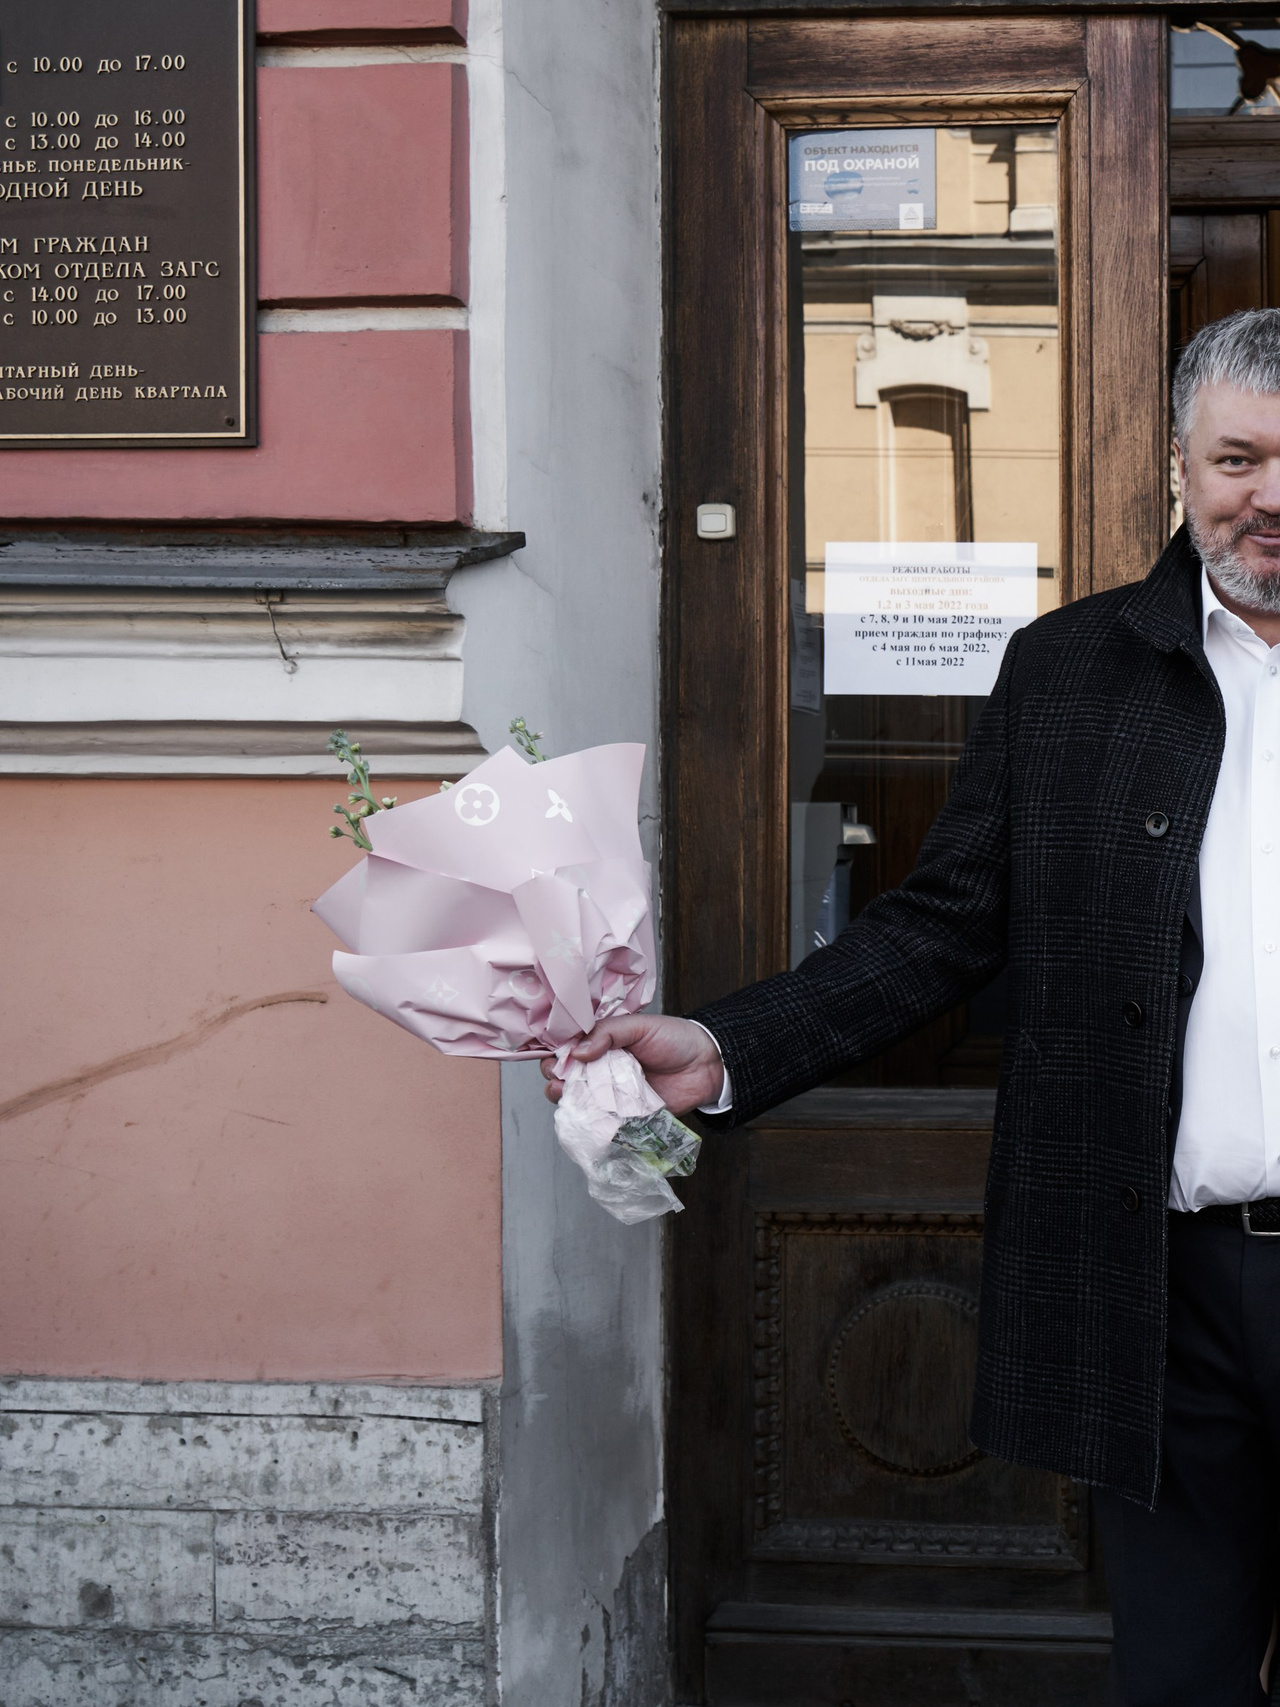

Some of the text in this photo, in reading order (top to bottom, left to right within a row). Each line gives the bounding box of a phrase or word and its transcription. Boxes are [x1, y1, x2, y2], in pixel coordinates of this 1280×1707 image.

[6, 54, 185, 74] с 10.00 до 17.00
[5, 109, 185, 129] с 10.00 до 16.00
[4, 131, 186, 151] с 13.00 до 14.00
[804, 146, 918, 155] ОБЪЕКТ НАХОДИТСЯ
[0, 160, 41, 173] НЬЕ.
[806, 155, 919, 173] ПОД ОХРАНОЙ
[81, 180, 143, 200] ДЕНЬ
[34, 236, 148, 255] ГРАЖДАН
[54, 261, 146, 281] ОТДЕЛА
[160, 261, 219, 277] ЗАГС
[3, 284, 186, 303] с 14.00 до 17.00
[3, 307, 187, 326] с 10.00 до 13.00
[0, 384, 227, 401] БОЧИЙ ДЕНЬ КВАРТАЛА
[892, 566, 971, 574] РЕЖИМ РАБОТЫ
[859, 575, 891, 583] ОТДЕЛА
[974, 575, 1005, 584] РАЙОНА
[890, 588, 973, 597] выходные дни:
[878, 600, 892, 611] 1,2
[904, 601, 911, 610] 3
[938, 601, 962, 611] 2022
[965, 604, 989, 612] года
[860, 616, 866, 624] с
[892, 614, 899, 623] 9
[902, 616, 909, 624] и
[913, 614, 925, 624] 10
[951, 615, 975, 625] 2022
[978, 617, 1002, 625] года
[854, 630, 889, 640] прием
[892, 630, 938, 640] граждан
[957, 629, 1008, 641] графику:
[872, 644, 878, 652] с
[880, 642, 887, 652] 4
[890, 644, 910, 652] мая
[929, 643, 936, 652] 6
[962, 643, 990, 653] 2022,
[941, 656, 965, 667] 2022
